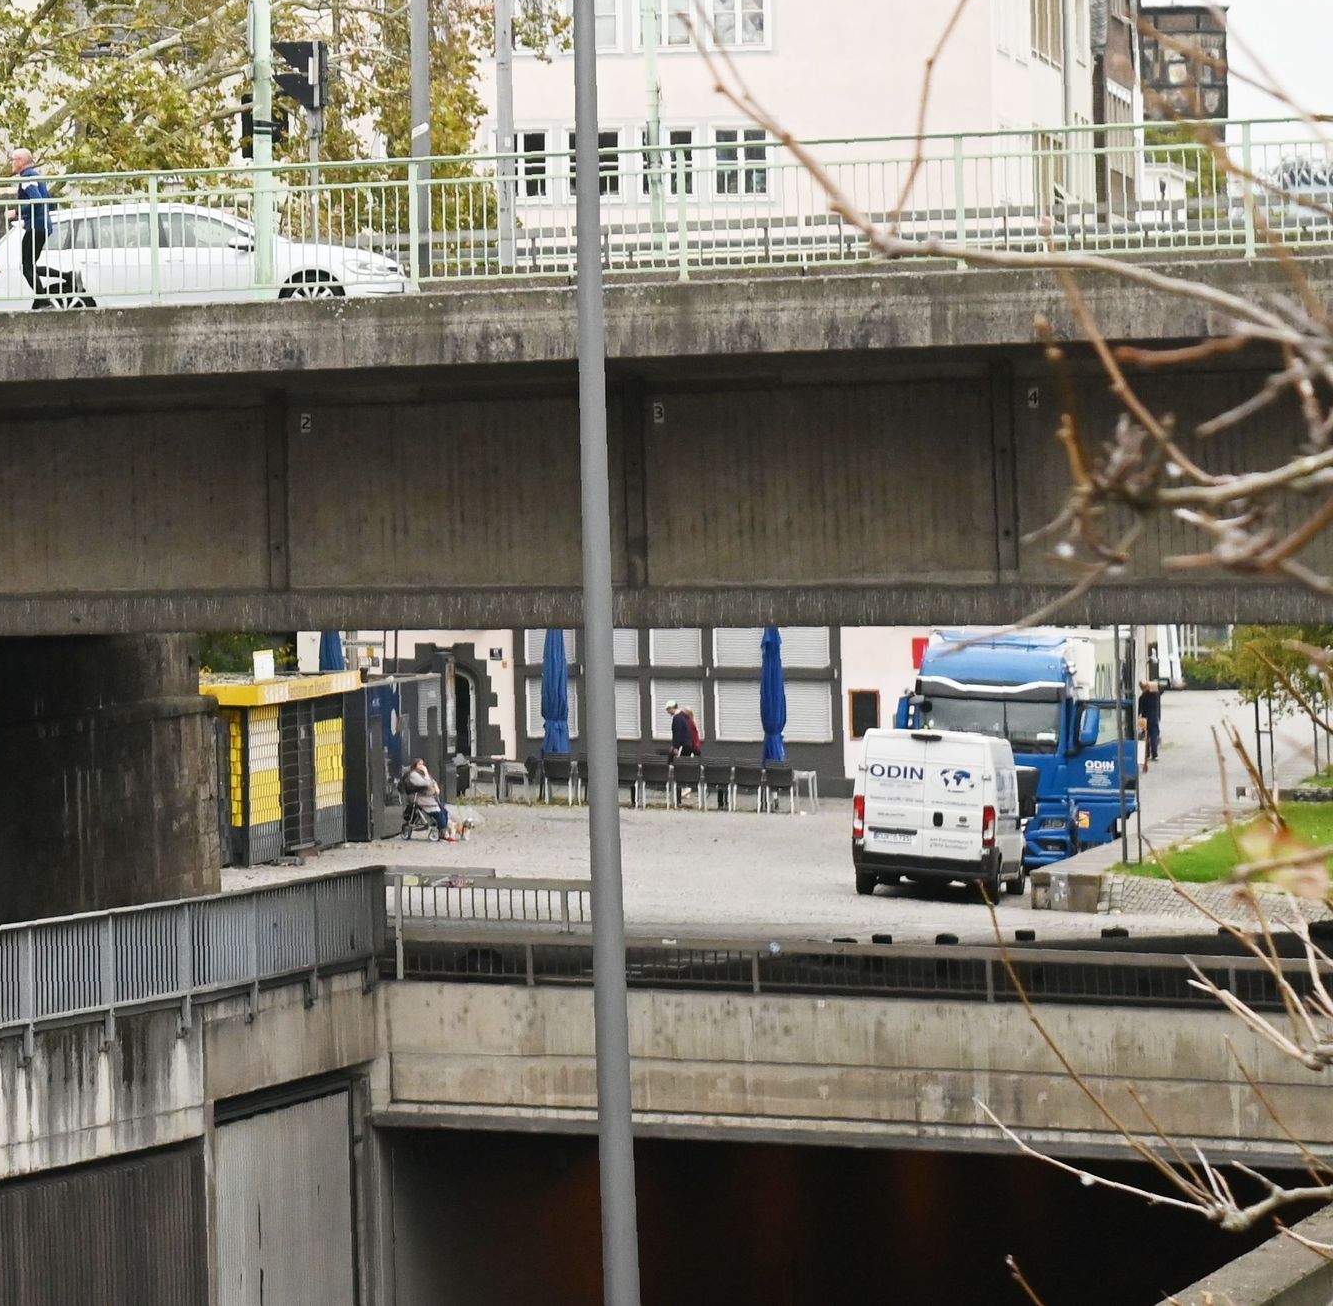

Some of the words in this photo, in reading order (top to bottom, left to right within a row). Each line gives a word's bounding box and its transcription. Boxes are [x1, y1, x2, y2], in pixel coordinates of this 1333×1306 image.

[1028, 390, 1037, 404] 4
[654, 405, 663, 419] 3
[302, 416, 310, 429] 2
[870, 763, 924, 781] ODIN
[1084, 759, 1115, 772] ODIN
